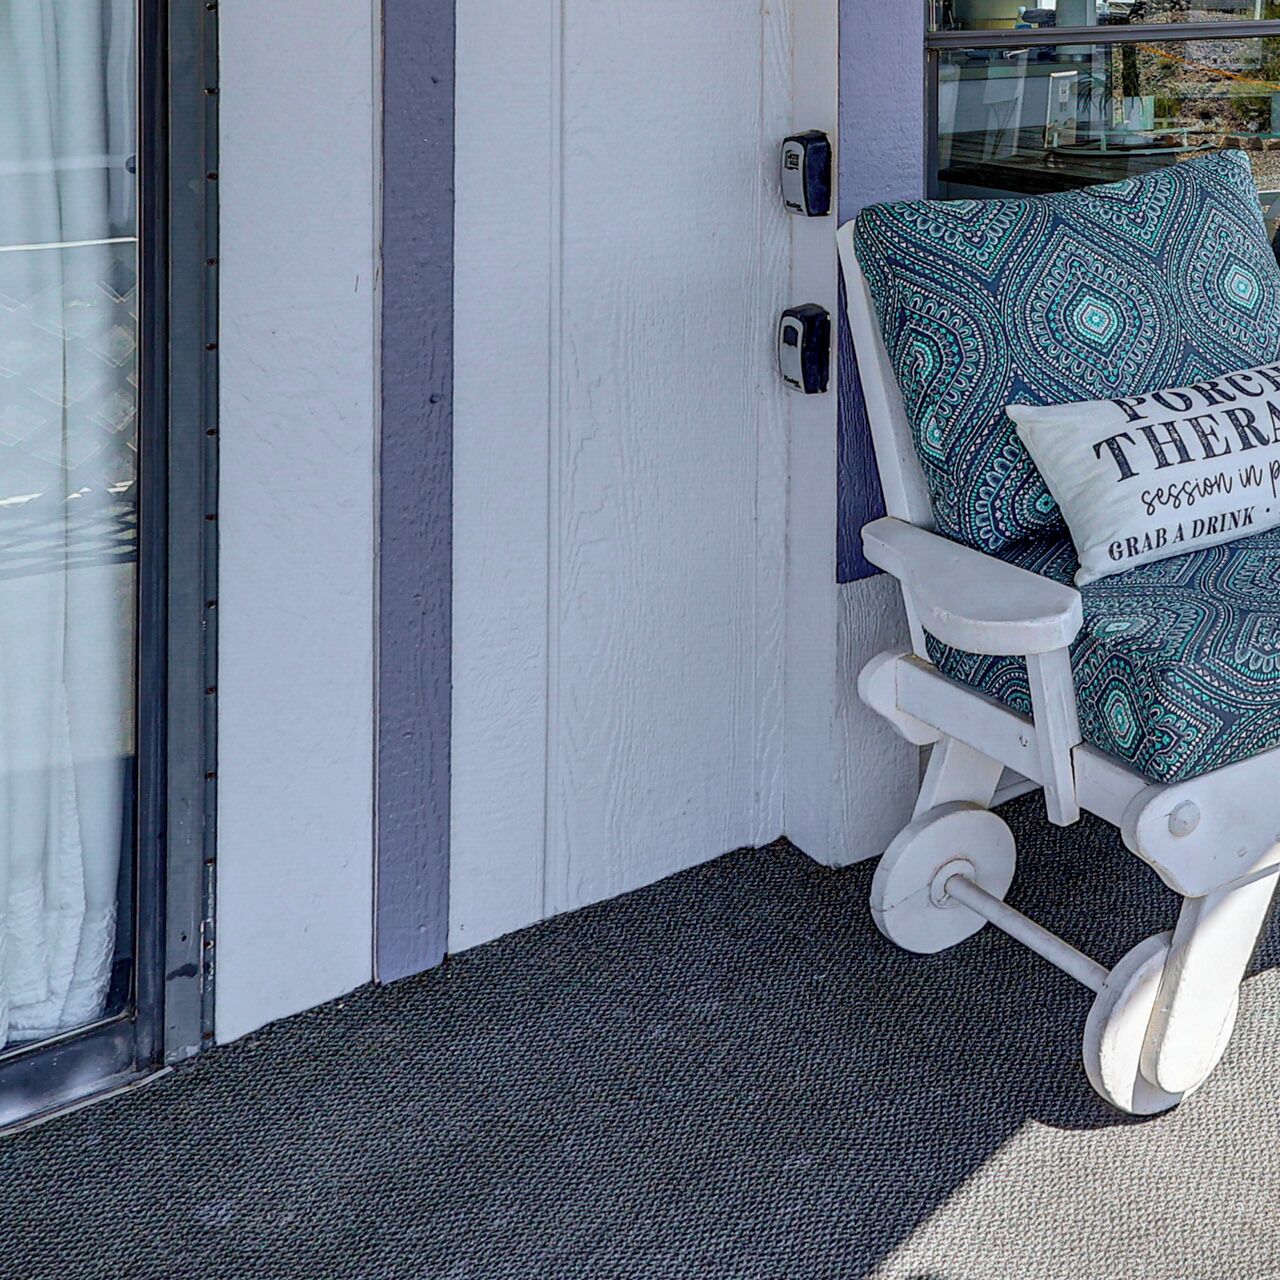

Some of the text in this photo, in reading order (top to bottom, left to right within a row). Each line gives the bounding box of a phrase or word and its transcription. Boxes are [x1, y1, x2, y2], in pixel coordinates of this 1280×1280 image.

[1141, 477, 1234, 517] session
[1239, 462, 1264, 489] in
[1107, 529, 1168, 563] GRAB
[1172, 521, 1186, 544] A
[1190, 505, 1257, 540] DRINK
